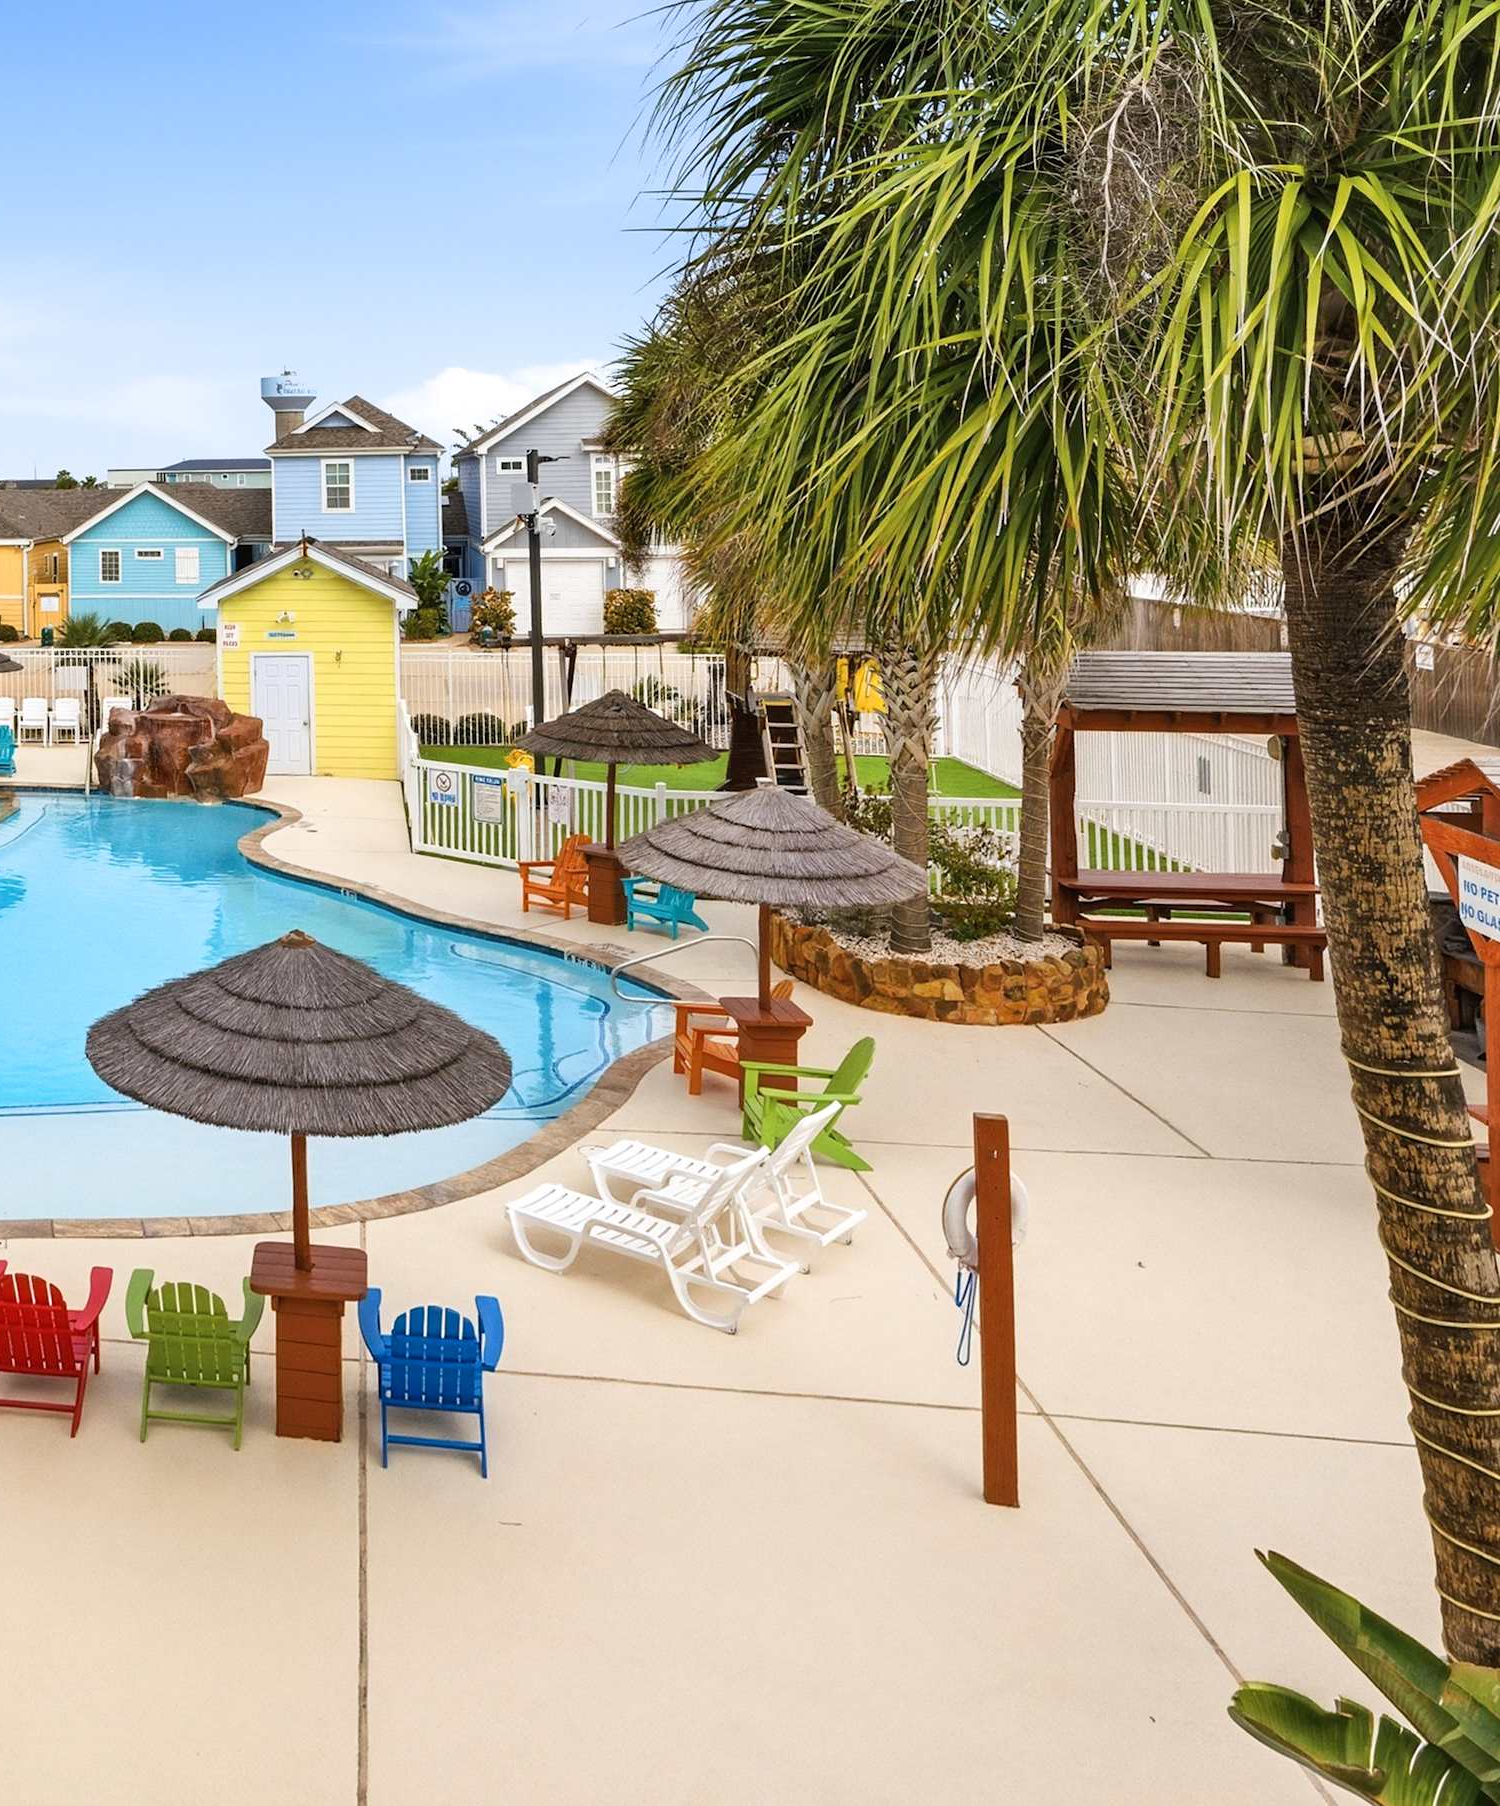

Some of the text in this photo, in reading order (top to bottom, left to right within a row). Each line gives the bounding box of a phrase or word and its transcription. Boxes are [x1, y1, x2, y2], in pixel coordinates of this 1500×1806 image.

[1463, 879, 1478, 896] NO
[1461, 902, 1500, 932] NO GLA
